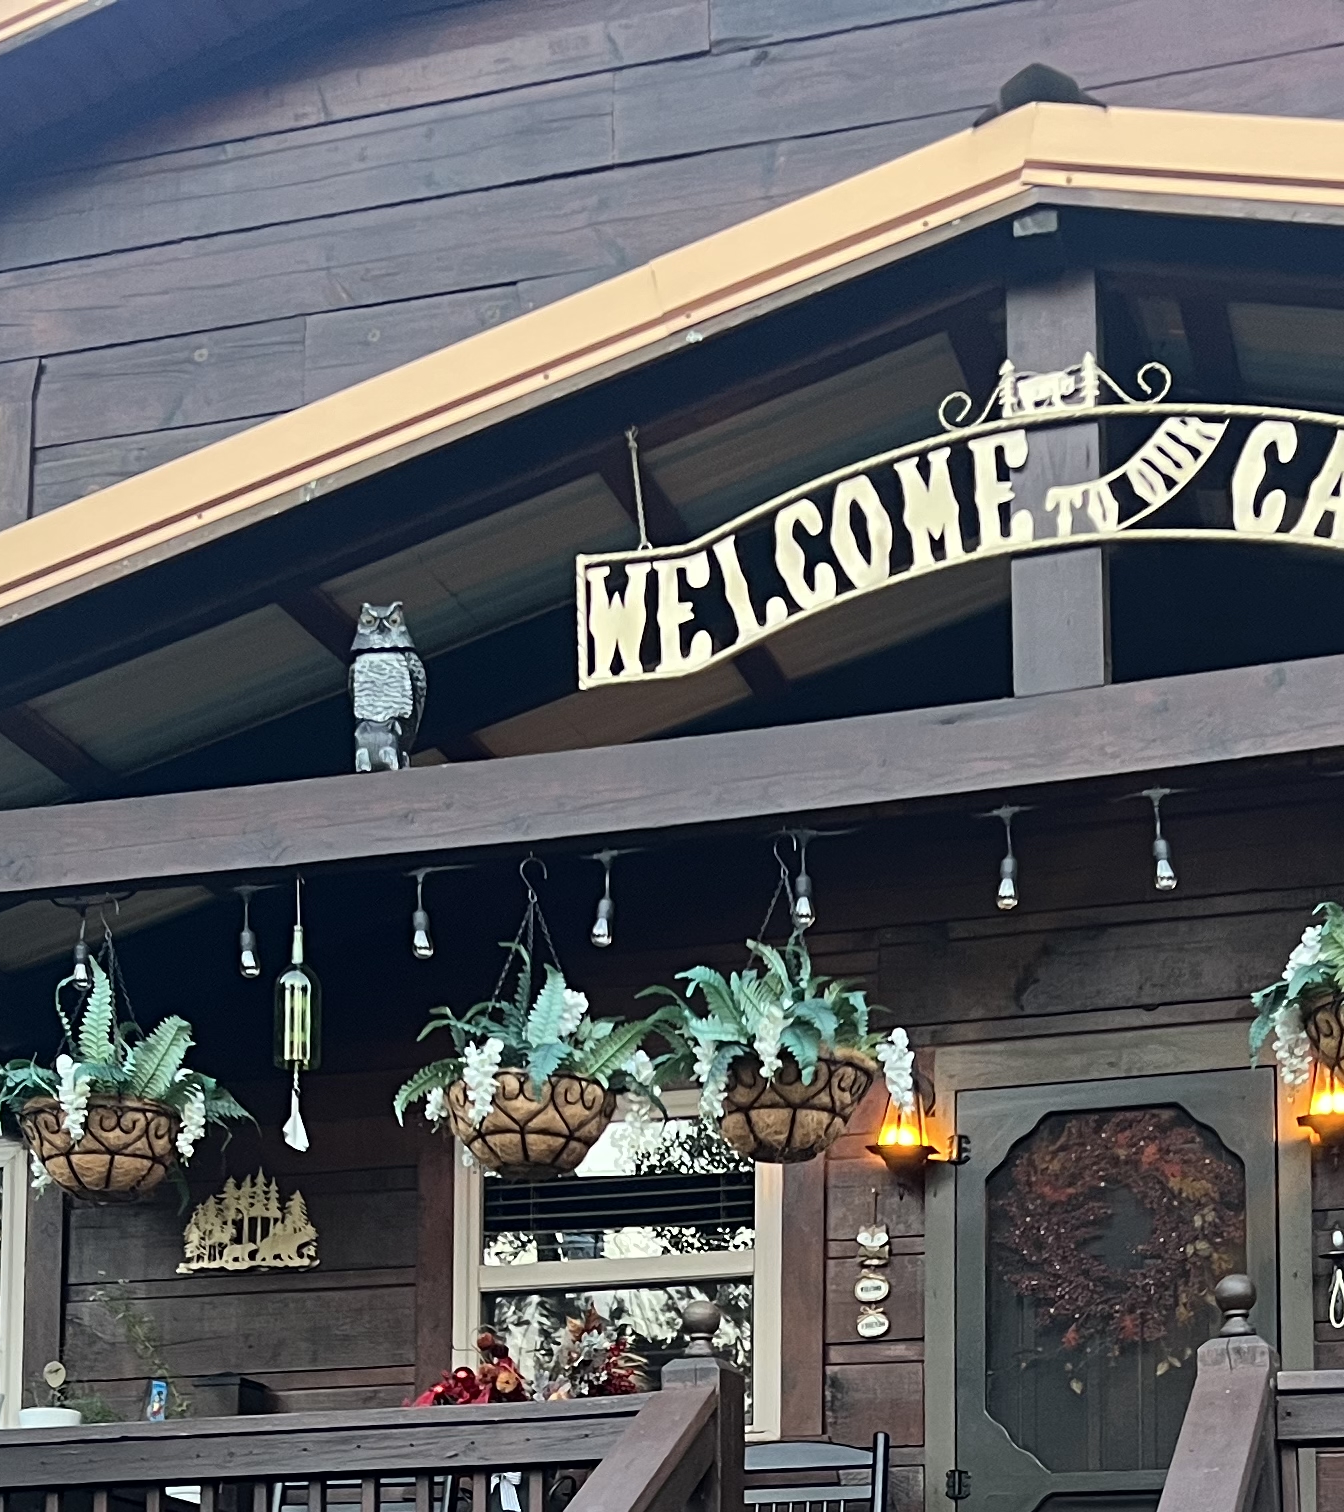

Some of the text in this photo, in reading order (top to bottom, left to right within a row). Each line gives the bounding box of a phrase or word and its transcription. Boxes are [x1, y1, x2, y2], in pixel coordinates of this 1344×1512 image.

[587, 430, 1033, 677] WELCOME
[1045, 485, 1120, 536] TO
[1126, 416, 1222, 506] OUR
